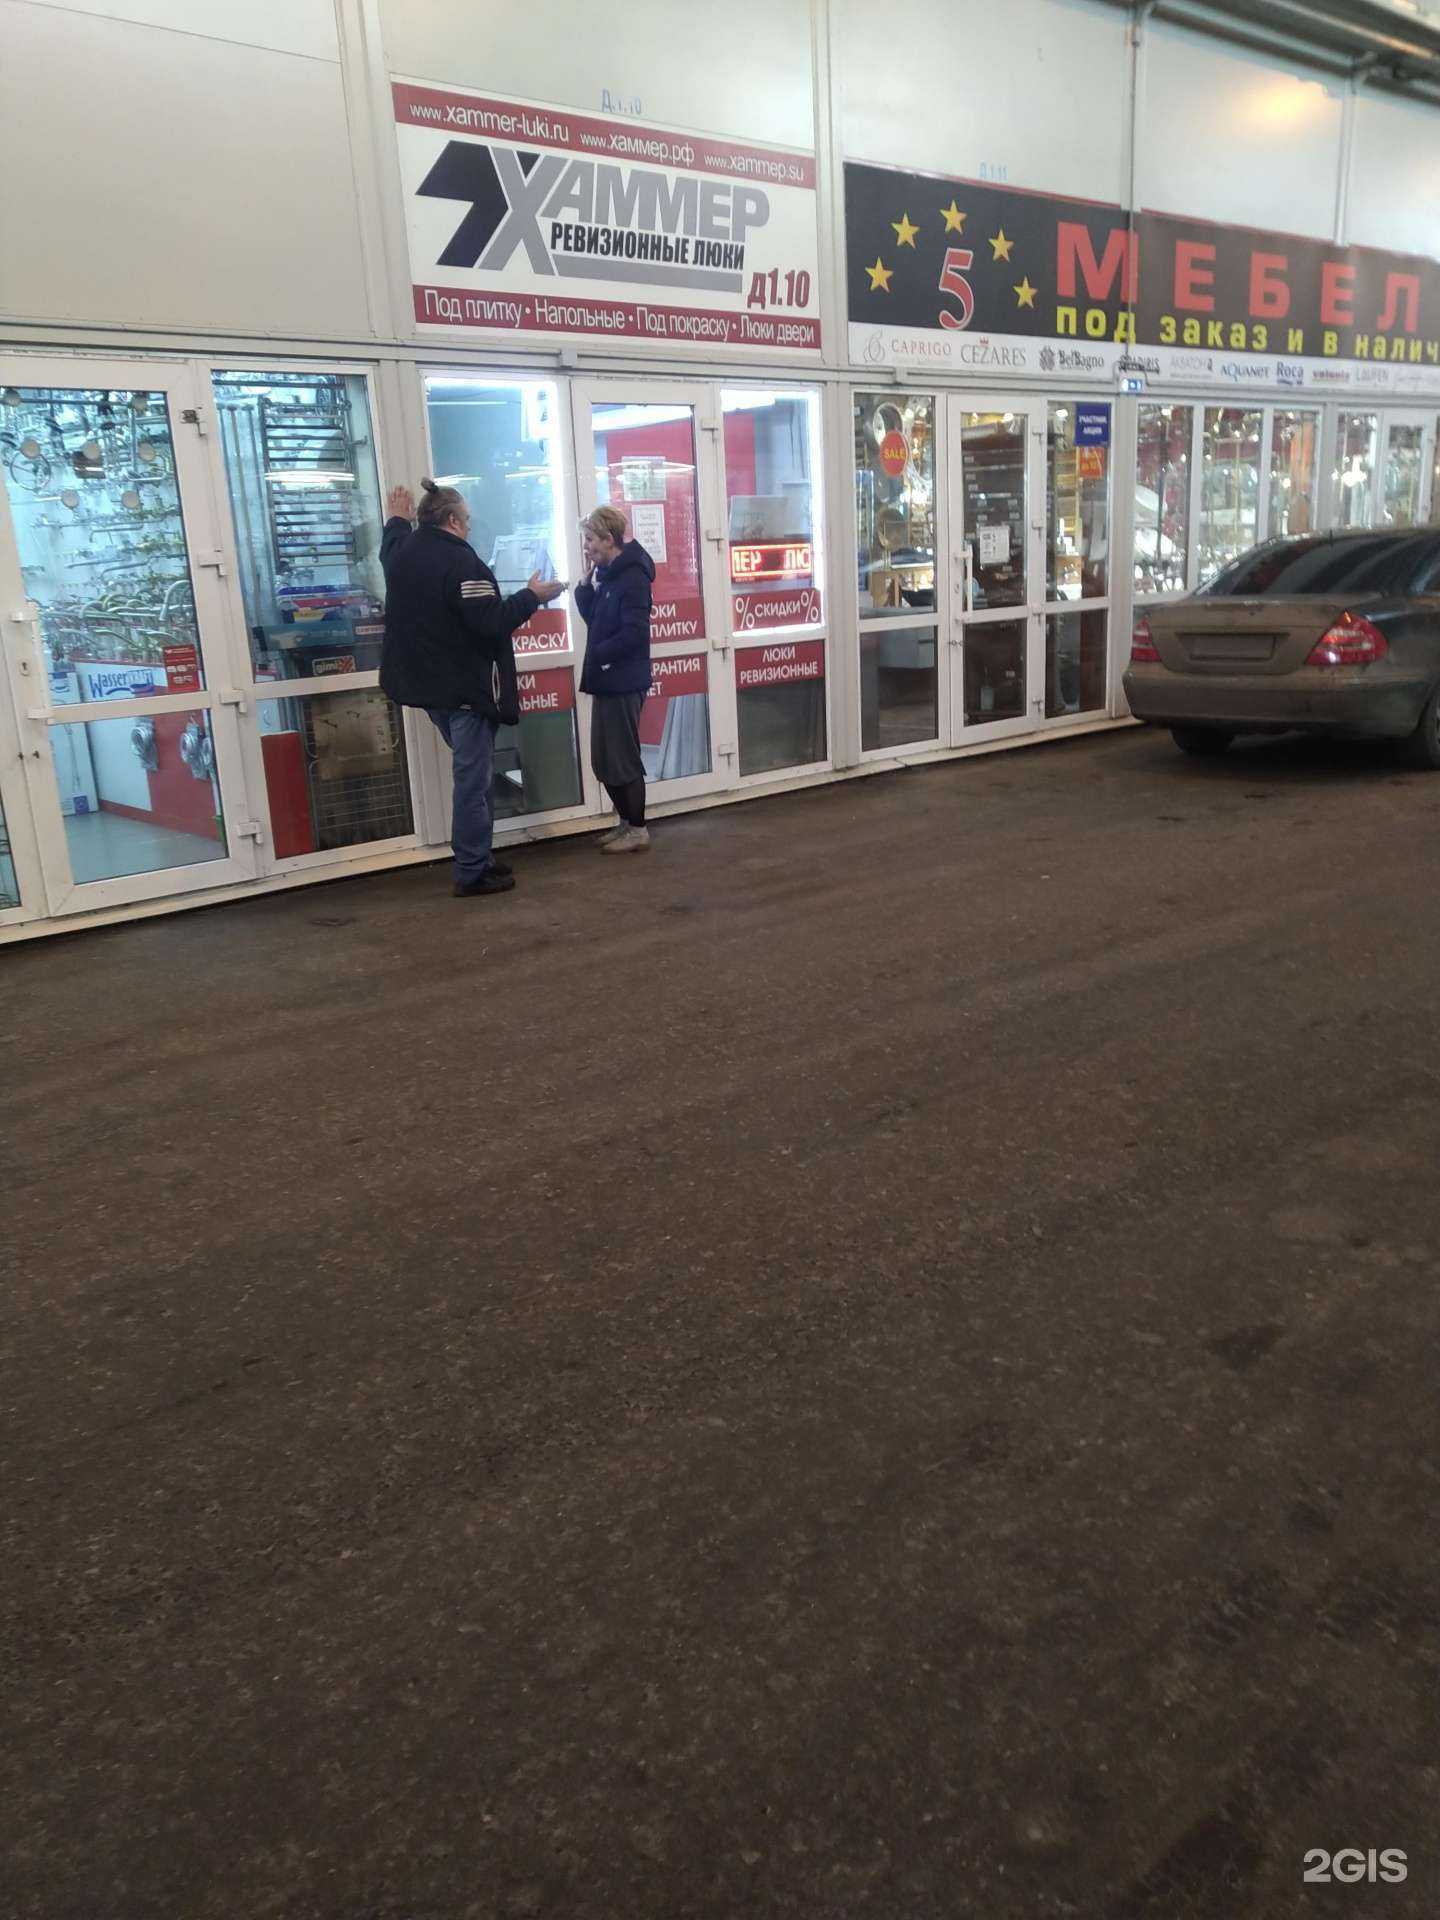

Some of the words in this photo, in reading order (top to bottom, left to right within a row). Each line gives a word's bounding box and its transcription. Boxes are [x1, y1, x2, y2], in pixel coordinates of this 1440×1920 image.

[409, 103, 570, 143] www.xammer-luki.ru
[477, 144, 770, 277] ХАММЕР
[550, 221, 689, 265] РЕВИЗИОННЫЕ
[692, 238, 745, 271] ЛЮКИ
[938, 247, 975, 331] 5
[1056, 220, 1422, 333] МЕБЕЛ
[424, 288, 463, 323] Под
[465, 297, 522, 329] плитку
[535, 298, 626, 330] Напольные
[637, 306, 668, 337] Под
[669, 311, 731, 342] покраску
[739, 314, 775, 340] Люки
[776, 320, 815, 345] двери
[1056, 305, 1137, 346] под
[1159, 315, 1268, 351] заказ
[1287, 327, 1304, 354] и
[1323, 330, 1338, 356] в
[1355, 333, 1440, 363] налич
[891, 339, 952, 357] CAPRIGO
[960, 342, 1027, 367] CEZARES
[1058, 349, 1105, 370] BelBagno
[1276, 360, 1304, 378] Roca
[754, 600, 801, 618] СКИДКИ
[650, 620, 698, 638] ПЛИТКУ
[762, 645, 796, 663] ЛЮКИ
[650, 657, 701, 678] РАНТИЯ
[740, 660, 819, 685] РЕВИЗИОННЫЕ
